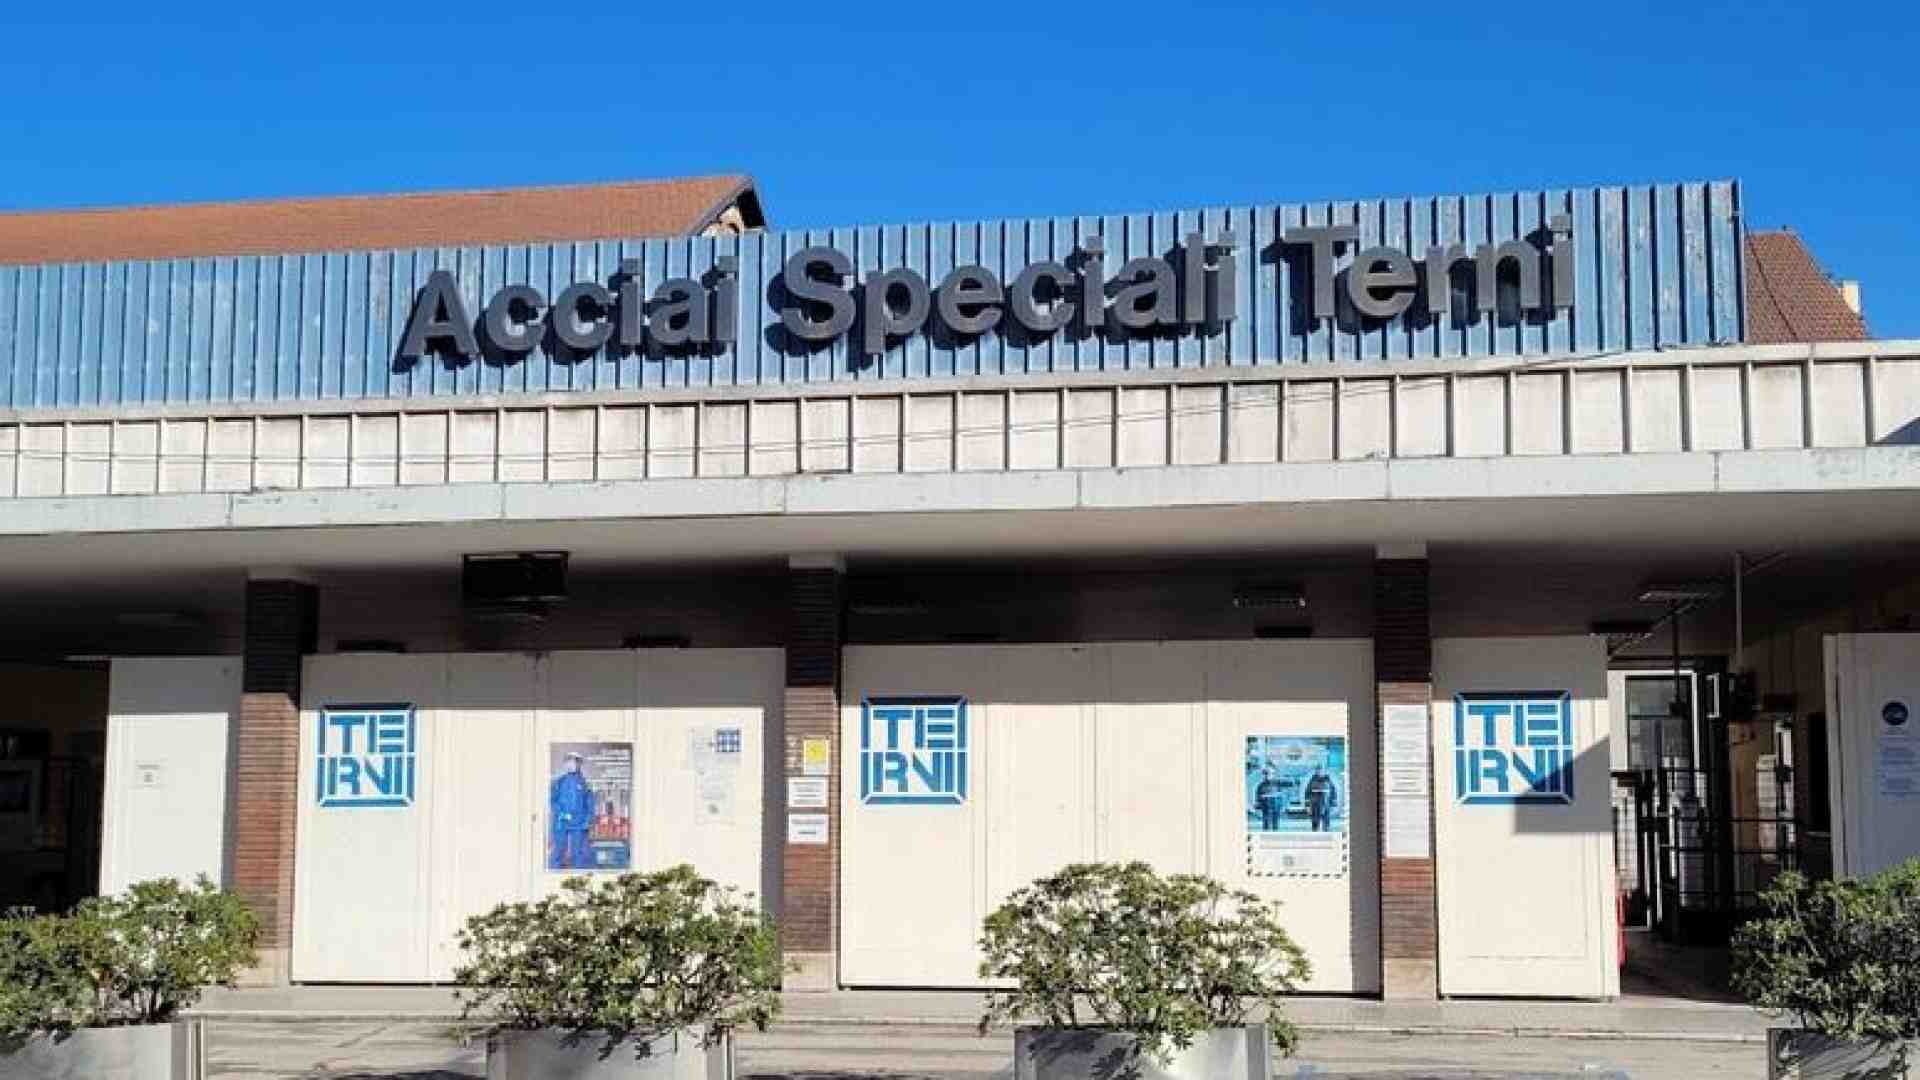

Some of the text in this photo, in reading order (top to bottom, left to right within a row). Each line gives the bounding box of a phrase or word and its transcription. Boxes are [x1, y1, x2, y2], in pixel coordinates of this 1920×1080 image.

[400, 214, 1575, 358] Acciai Speciali Terni
